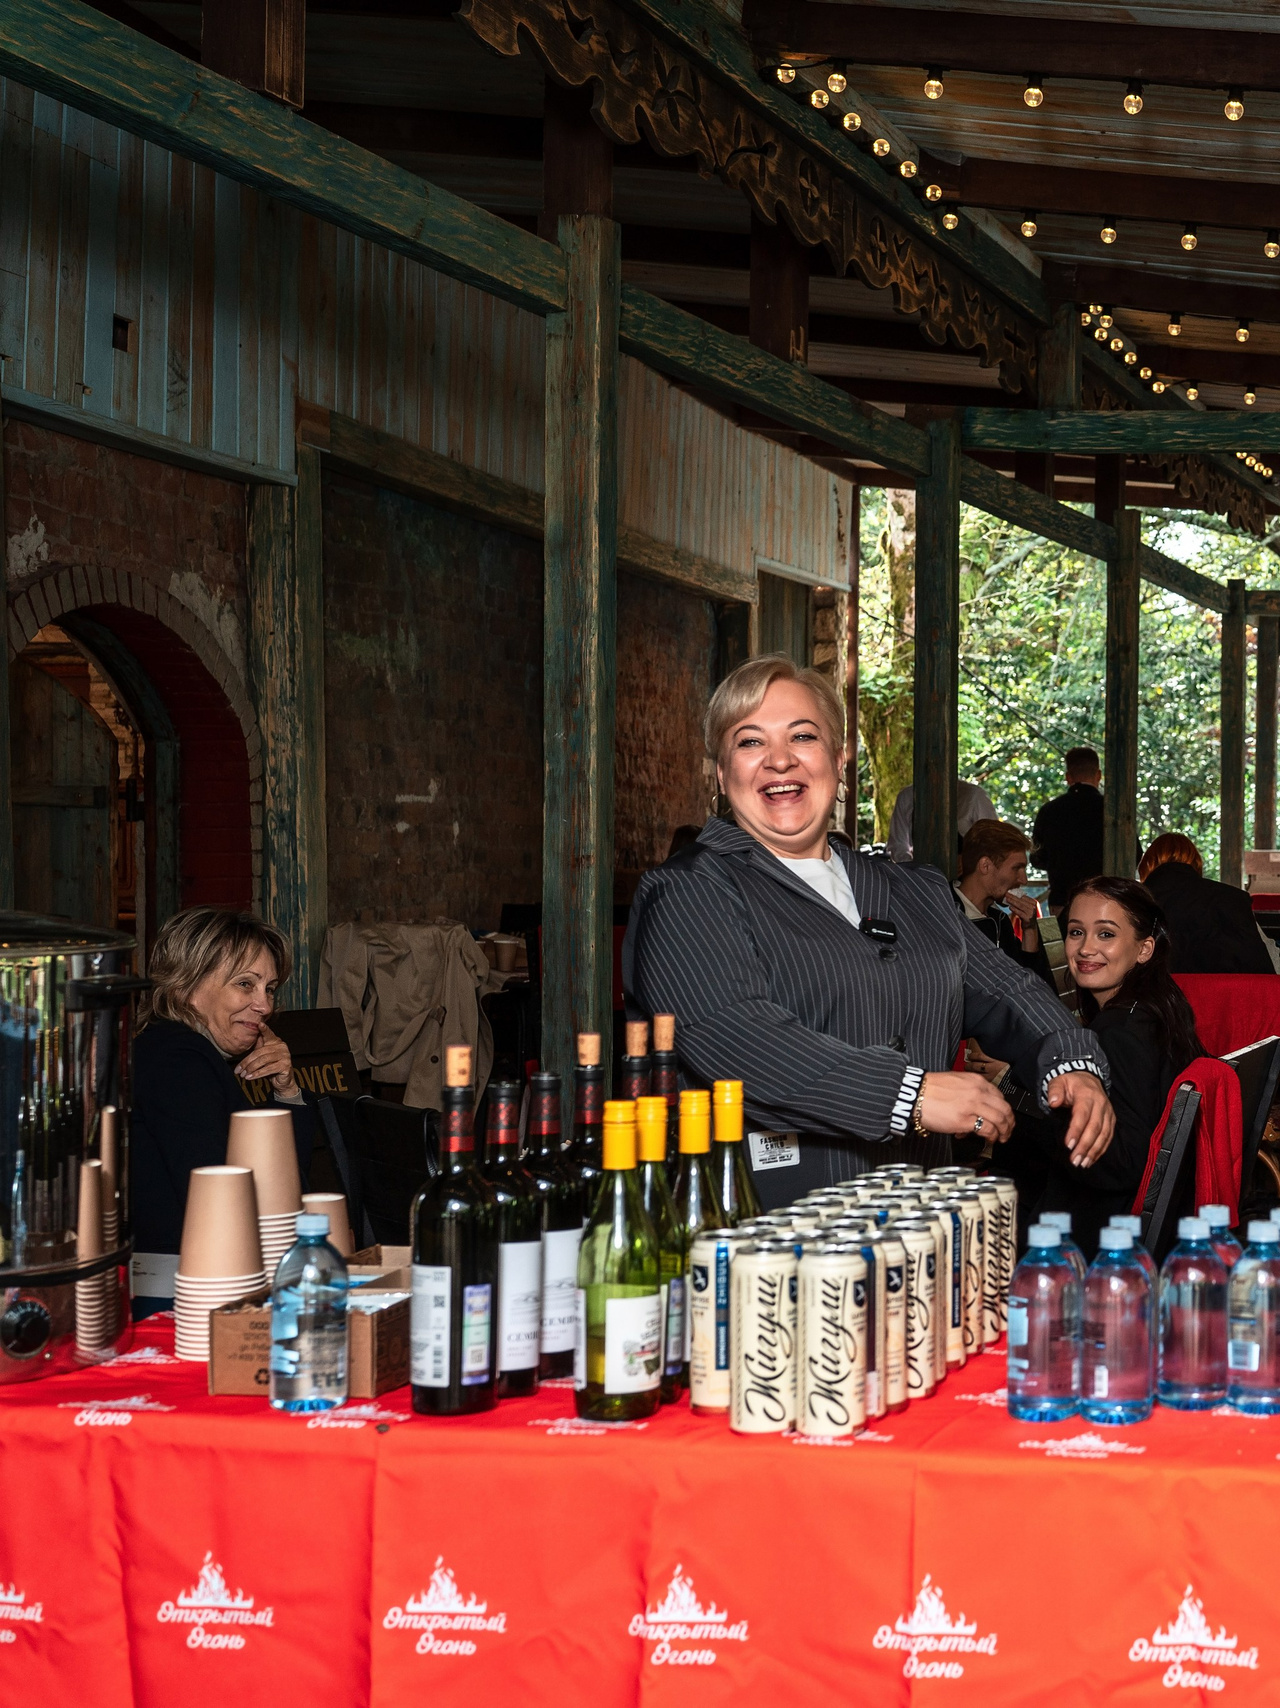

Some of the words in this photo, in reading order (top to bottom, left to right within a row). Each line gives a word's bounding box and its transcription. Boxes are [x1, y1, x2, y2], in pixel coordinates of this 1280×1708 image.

[744, 1271, 794, 1424] Жигули
[808, 1275, 857, 1427] Жигули
[157, 1600, 274, 1628] Открытый
[383, 1606, 508, 1634] Открытый
[628, 1613, 750, 1642] Открытый
[186, 1625, 246, 1649] Огонь
[415, 1631, 477, 1656] Огонь
[872, 1624, 999, 1656] Открытый
[650, 1641, 717, 1666] Огонь
[902, 1655, 965, 1679] Огонь
[1128, 1637, 1260, 1670] Открытый
[1162, 1662, 1226, 1692] Огонь
